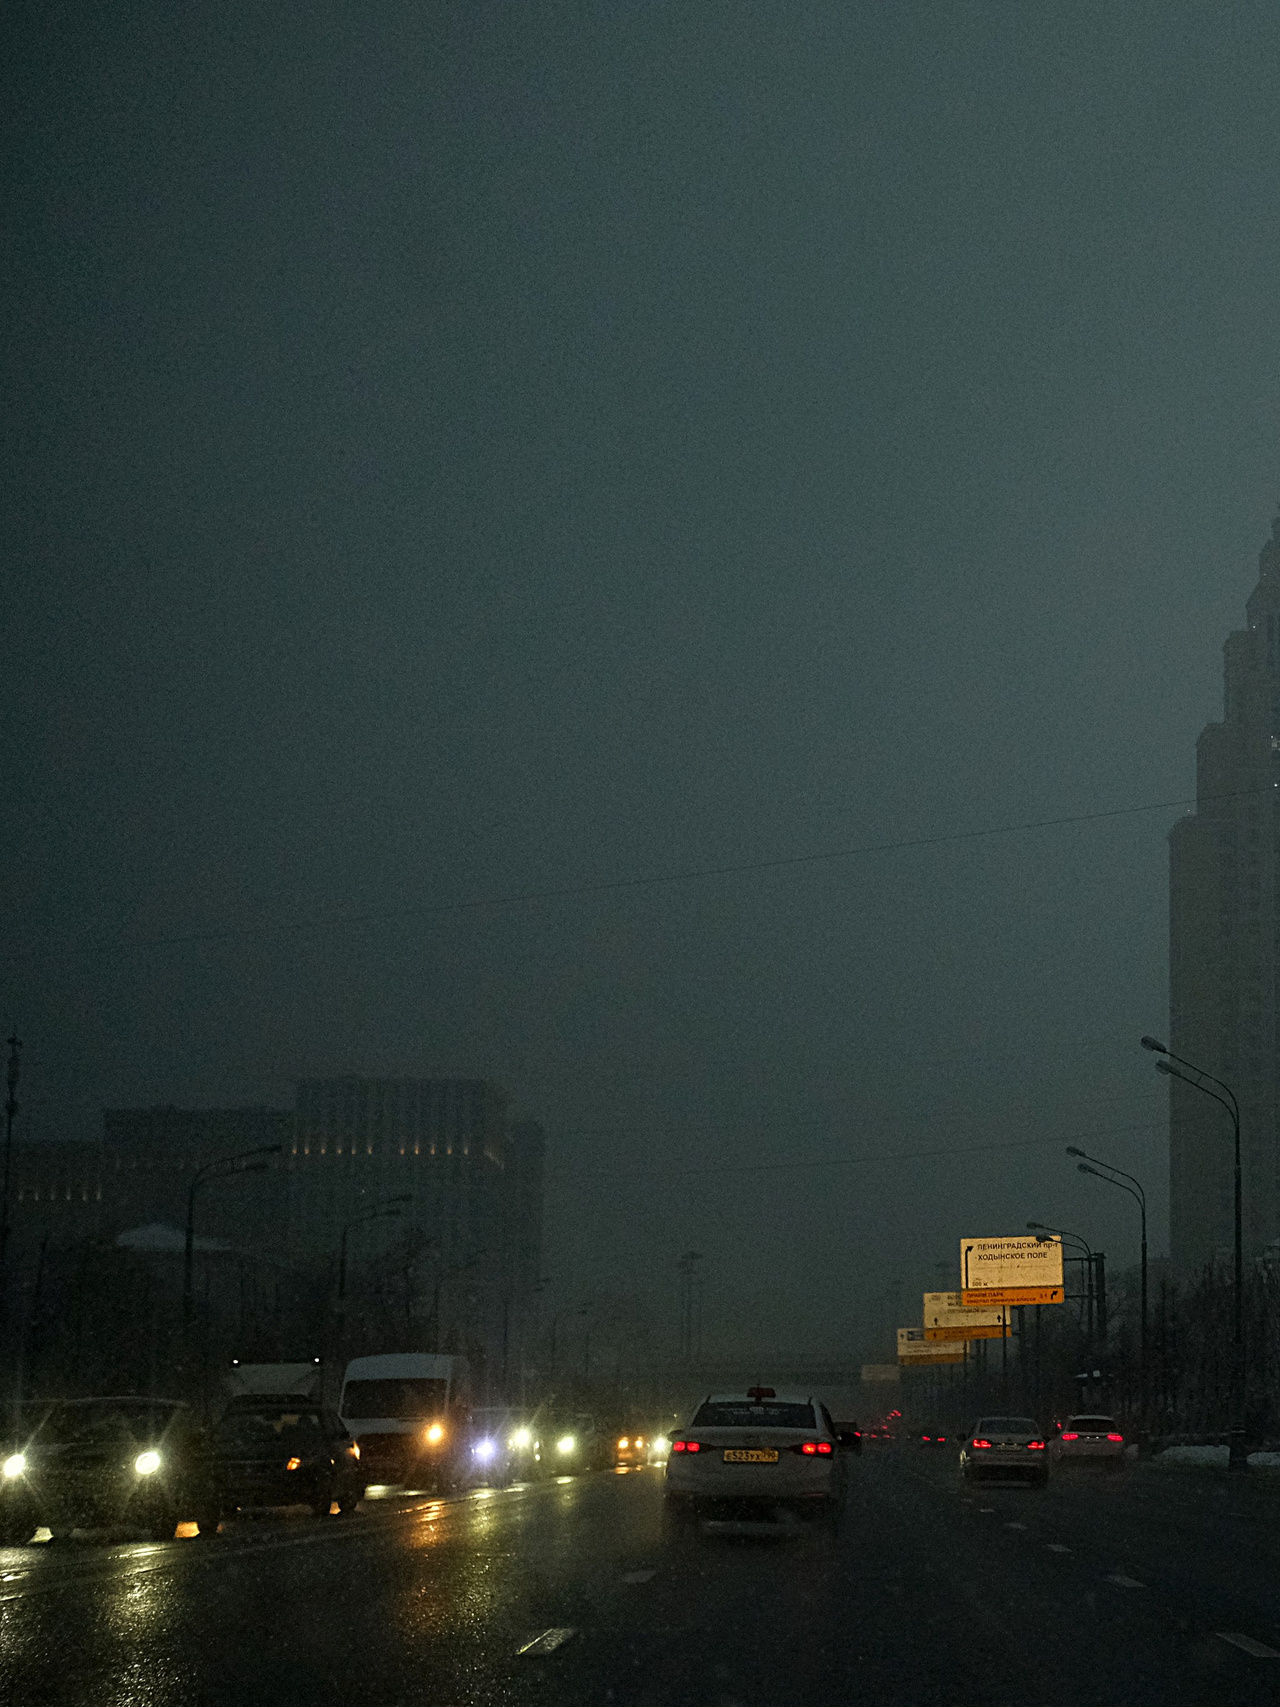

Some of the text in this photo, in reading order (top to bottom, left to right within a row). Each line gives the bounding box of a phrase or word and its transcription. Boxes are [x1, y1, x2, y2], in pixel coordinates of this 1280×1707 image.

[977, 1241, 1042, 1251] ЛЕНИНГРАДСКИЙ
[977, 1251, 1047, 1261] ХОДЫНСКОЕ ПОЛЕ
